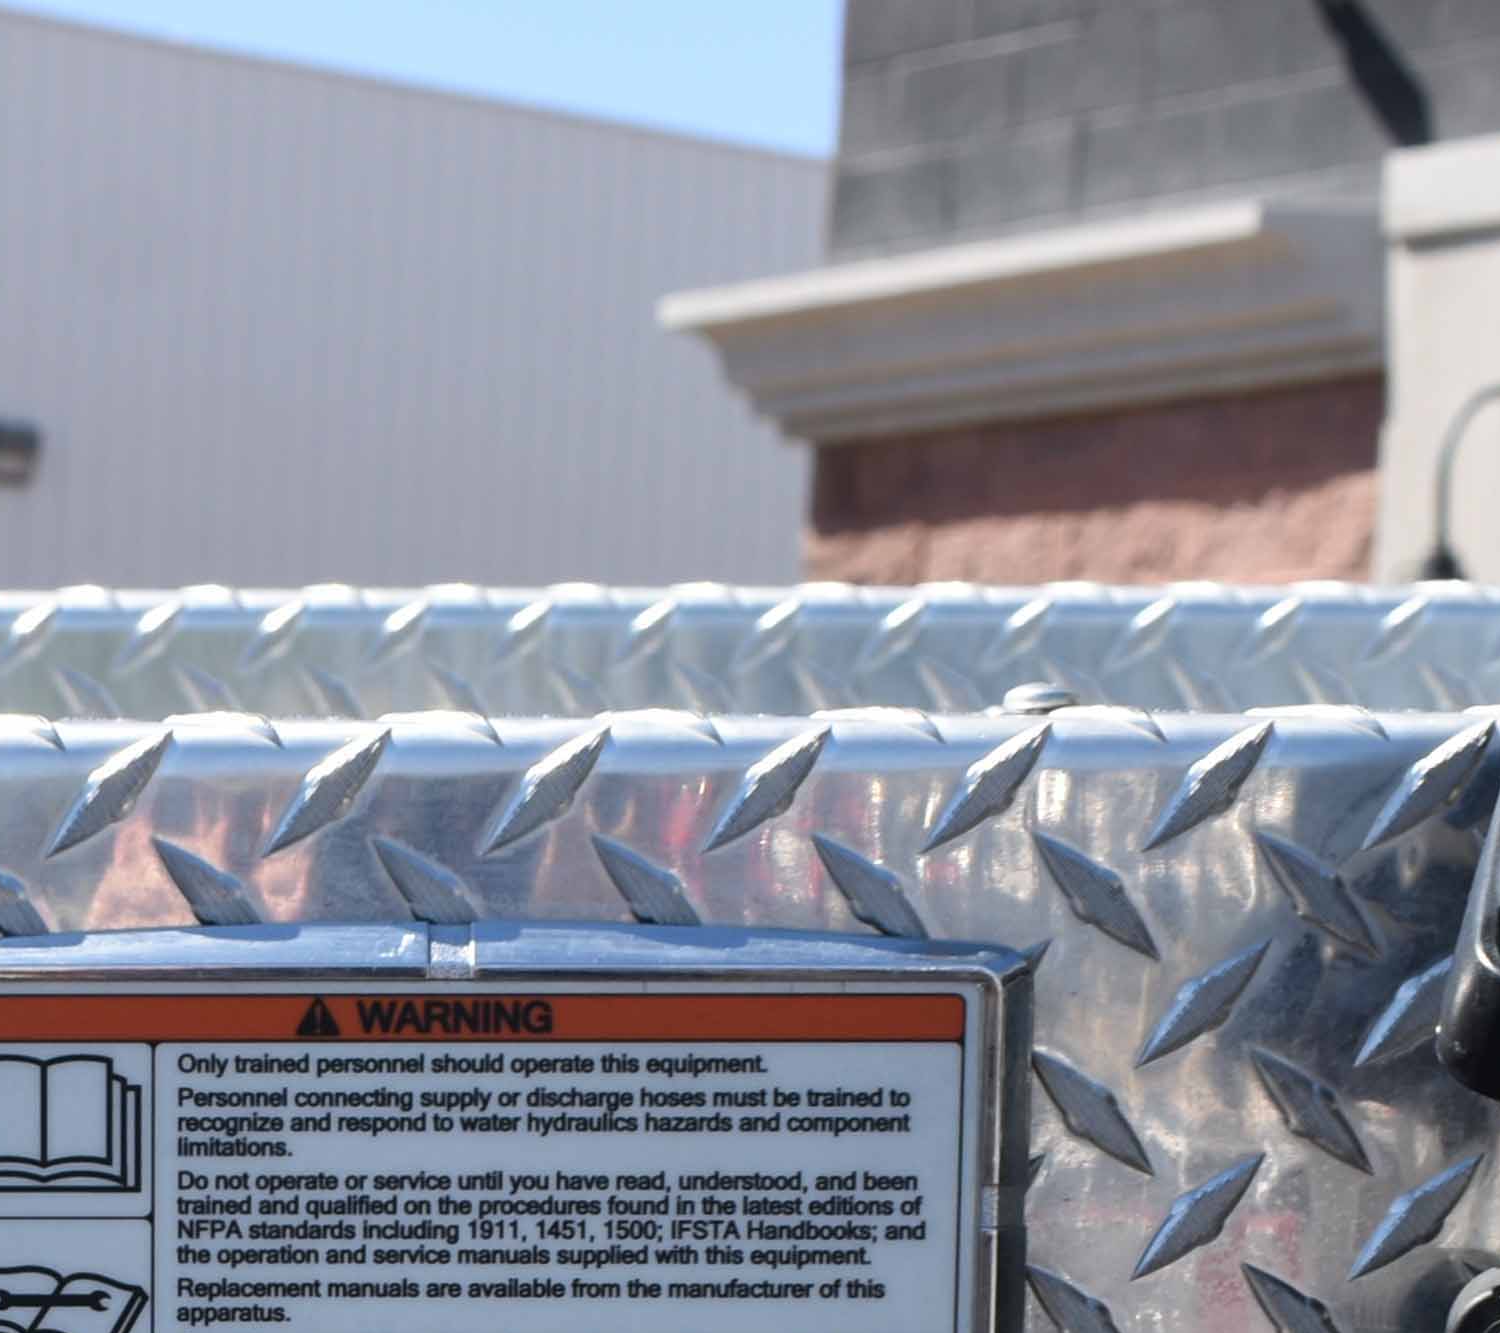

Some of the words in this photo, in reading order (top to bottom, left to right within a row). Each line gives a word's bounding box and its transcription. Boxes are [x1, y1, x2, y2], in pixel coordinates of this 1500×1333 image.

[357, 999, 553, 1034] WARNING
[178, 1053, 228, 1078] Only
[234, 1053, 310, 1074] trained
[316, 1053, 424, 1078] personnel
[431, 1053, 504, 1074] should
[510, 1055, 595, 1078] operate
[600, 1053, 640, 1073] this
[646, 1053, 768, 1078] equipment.
